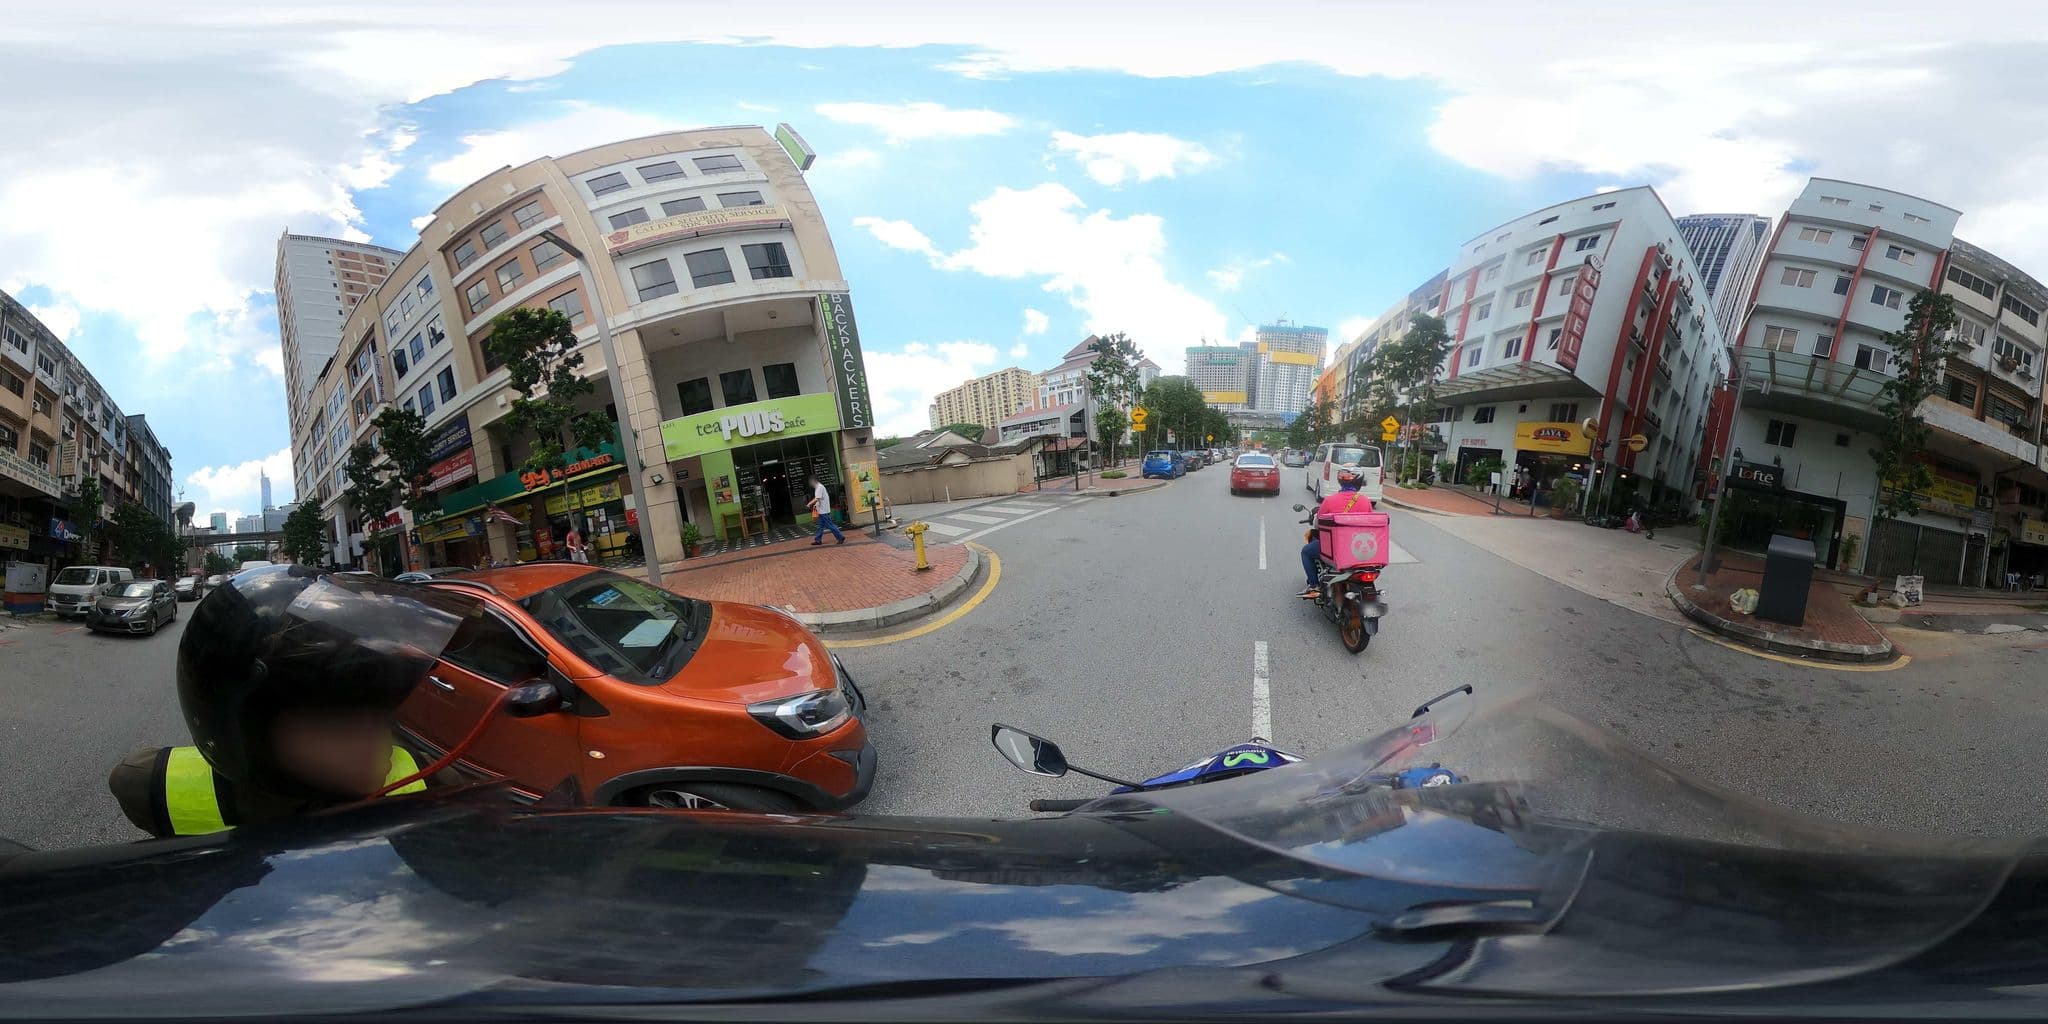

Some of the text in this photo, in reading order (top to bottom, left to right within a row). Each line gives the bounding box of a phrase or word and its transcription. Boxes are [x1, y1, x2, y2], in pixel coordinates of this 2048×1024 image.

[677, 212, 728, 226] SECURITY
[728, 207, 777, 218] SERVICES
[1566, 269, 1601, 354] HOTEL
[831, 294, 863, 427] BACKPACKERS
[784, 416, 807, 431] cafe
[1540, 429, 1562, 437] JAYA
[520, 468, 551, 492] 99
